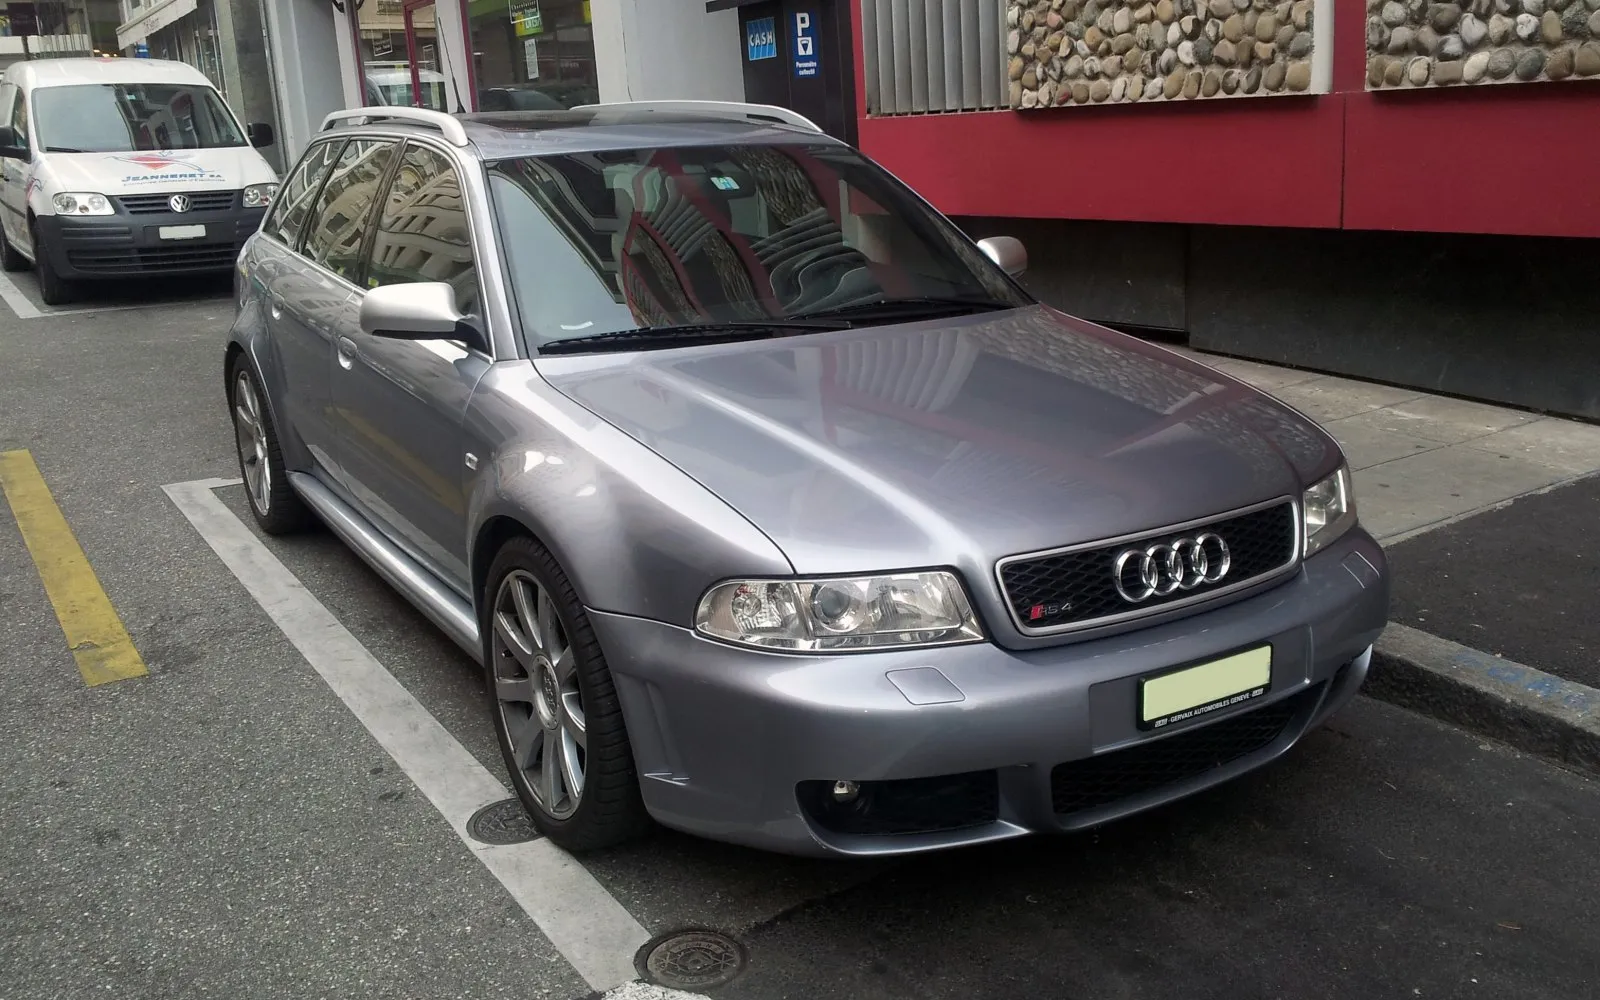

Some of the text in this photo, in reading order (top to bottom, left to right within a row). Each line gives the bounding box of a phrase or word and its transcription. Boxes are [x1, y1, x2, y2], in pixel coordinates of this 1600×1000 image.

[796, 12, 810, 37] P
[749, 31, 773, 47] CASH
[122, 173, 206, 182] JEANNERET
[1170, 711, 1193, 723] GERVAIX
[1194, 700, 1230, 714] AUTOMOBILES
